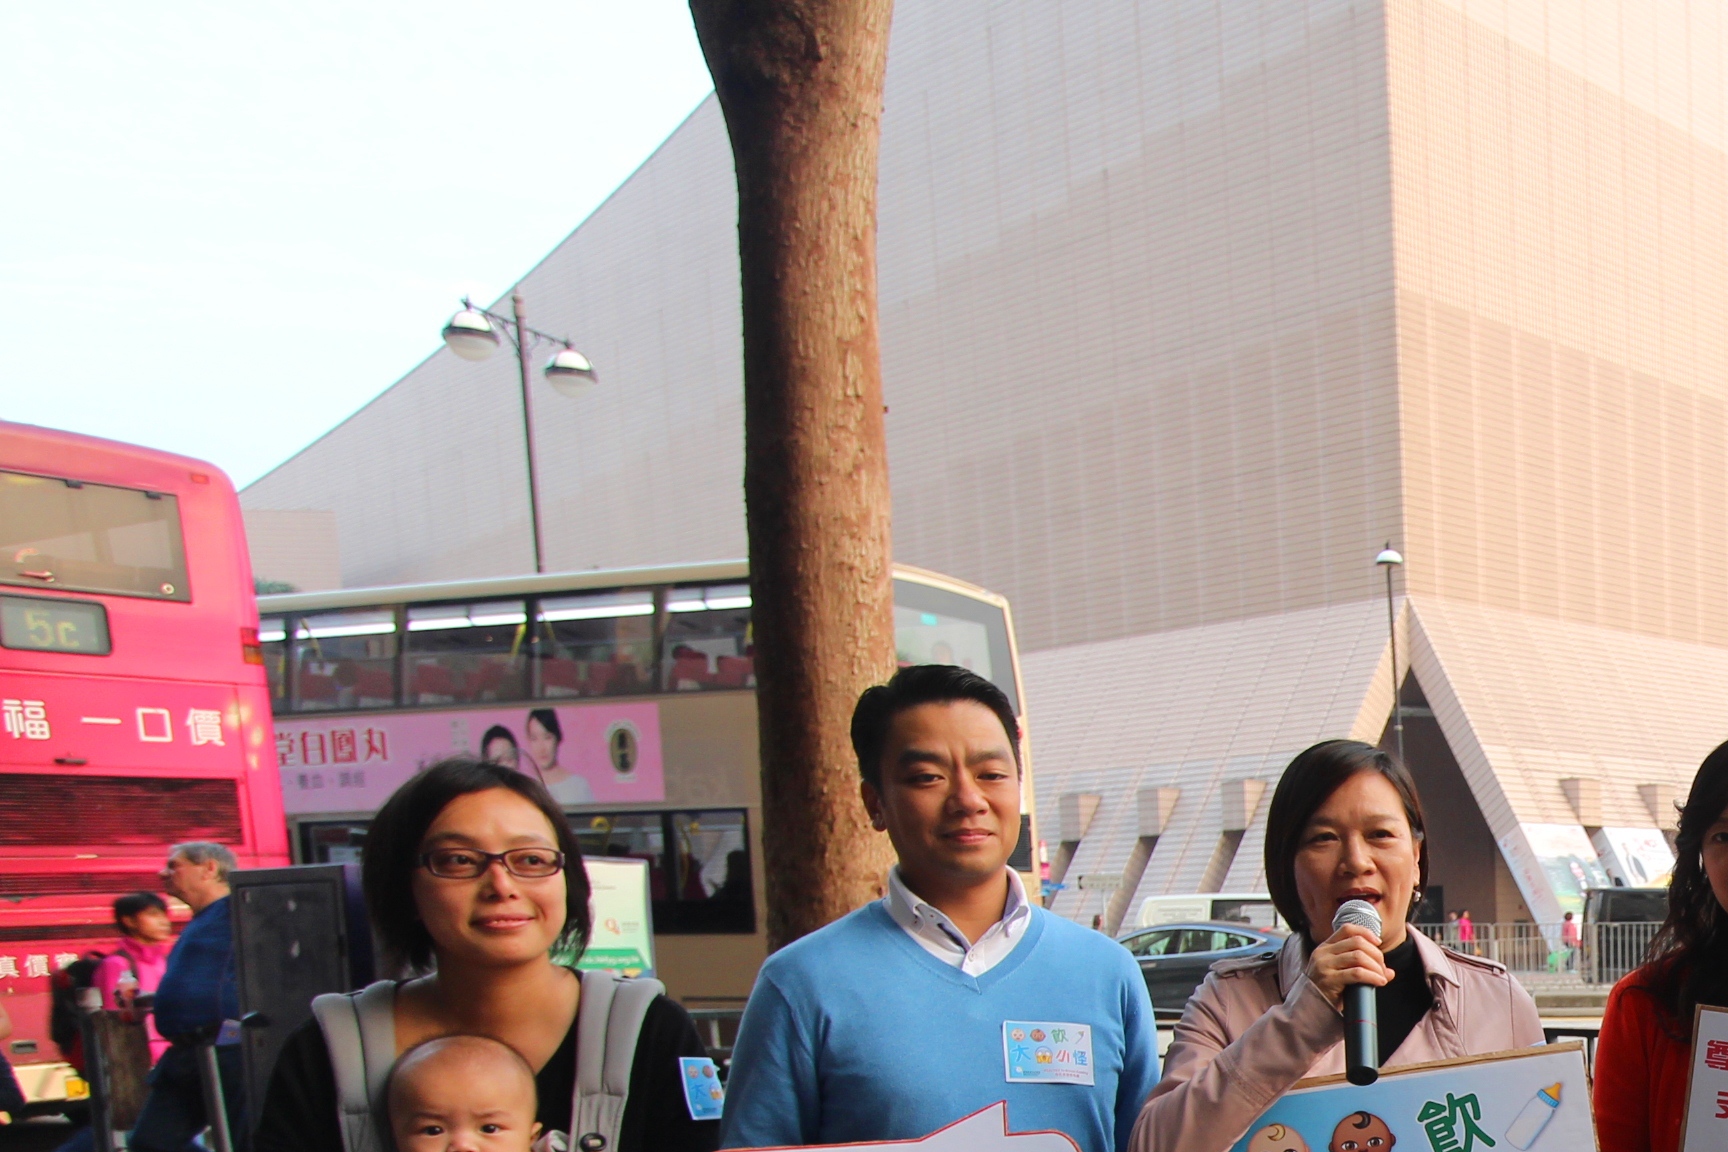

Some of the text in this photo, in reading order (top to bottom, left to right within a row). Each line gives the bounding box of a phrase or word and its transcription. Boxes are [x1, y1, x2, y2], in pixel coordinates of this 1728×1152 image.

[2, 699, 225, 746] 福 一口價
